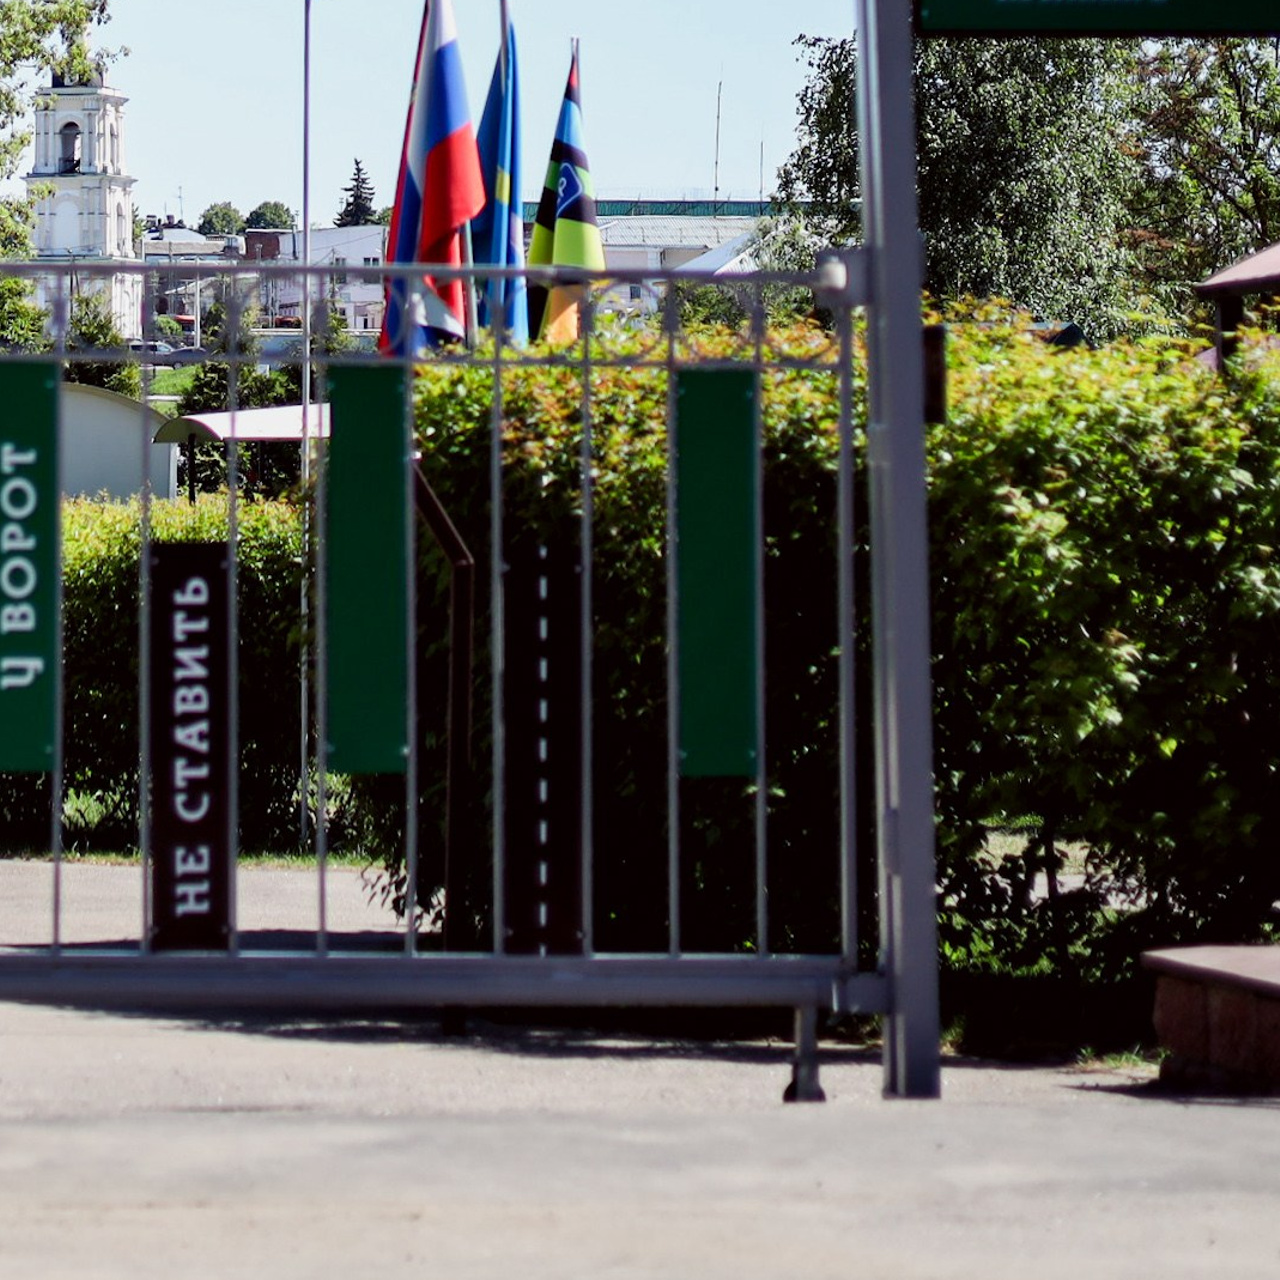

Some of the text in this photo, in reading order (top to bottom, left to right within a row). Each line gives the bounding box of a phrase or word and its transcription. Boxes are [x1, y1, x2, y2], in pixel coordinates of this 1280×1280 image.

[0, 442, 37, 634] ВОРОТ
[173, 576, 211, 916] НЕ СТАВИТЬ
